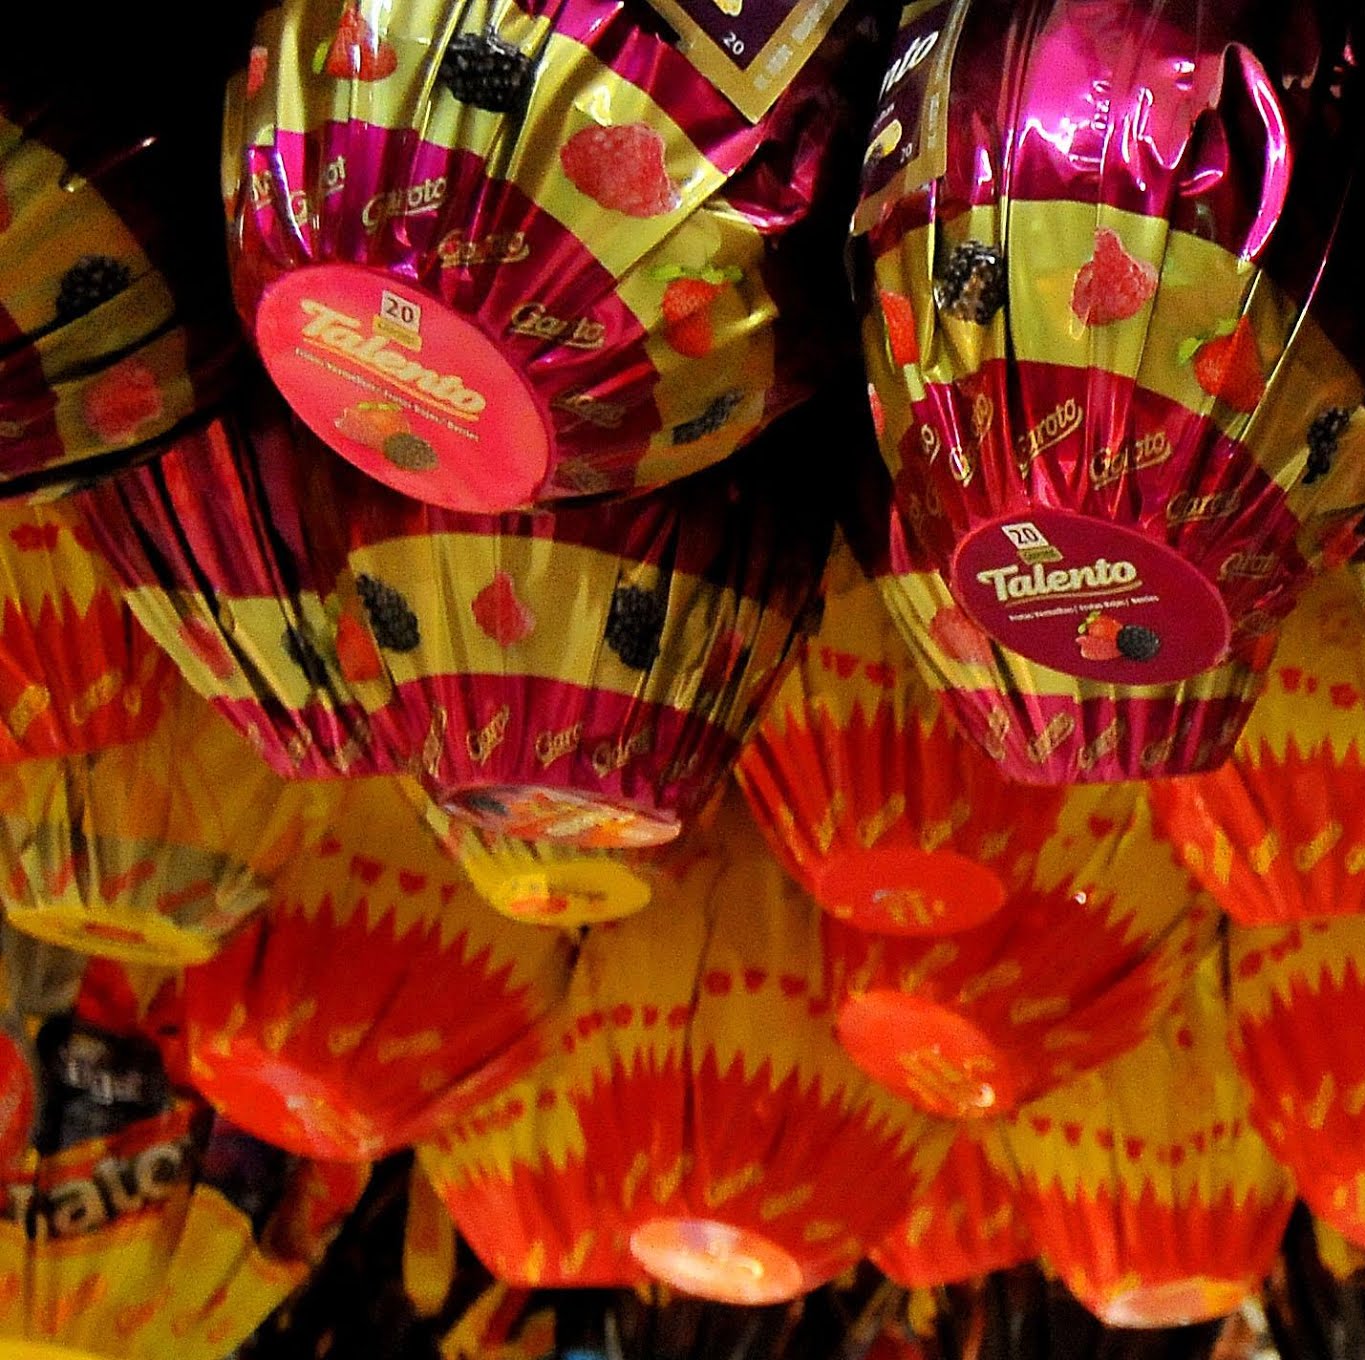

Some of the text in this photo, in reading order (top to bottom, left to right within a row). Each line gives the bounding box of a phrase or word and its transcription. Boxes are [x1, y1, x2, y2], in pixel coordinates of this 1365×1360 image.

[723, 31, 745, 55] 20
[386, 297, 414, 324] 20
[511, 302, 606, 348] Gato
[300, 299, 487, 416] Talento
[1089, 430, 1173, 491] Gaoto
[1009, 526, 1040, 545] 20
[976, 558, 1137, 602] Talento
